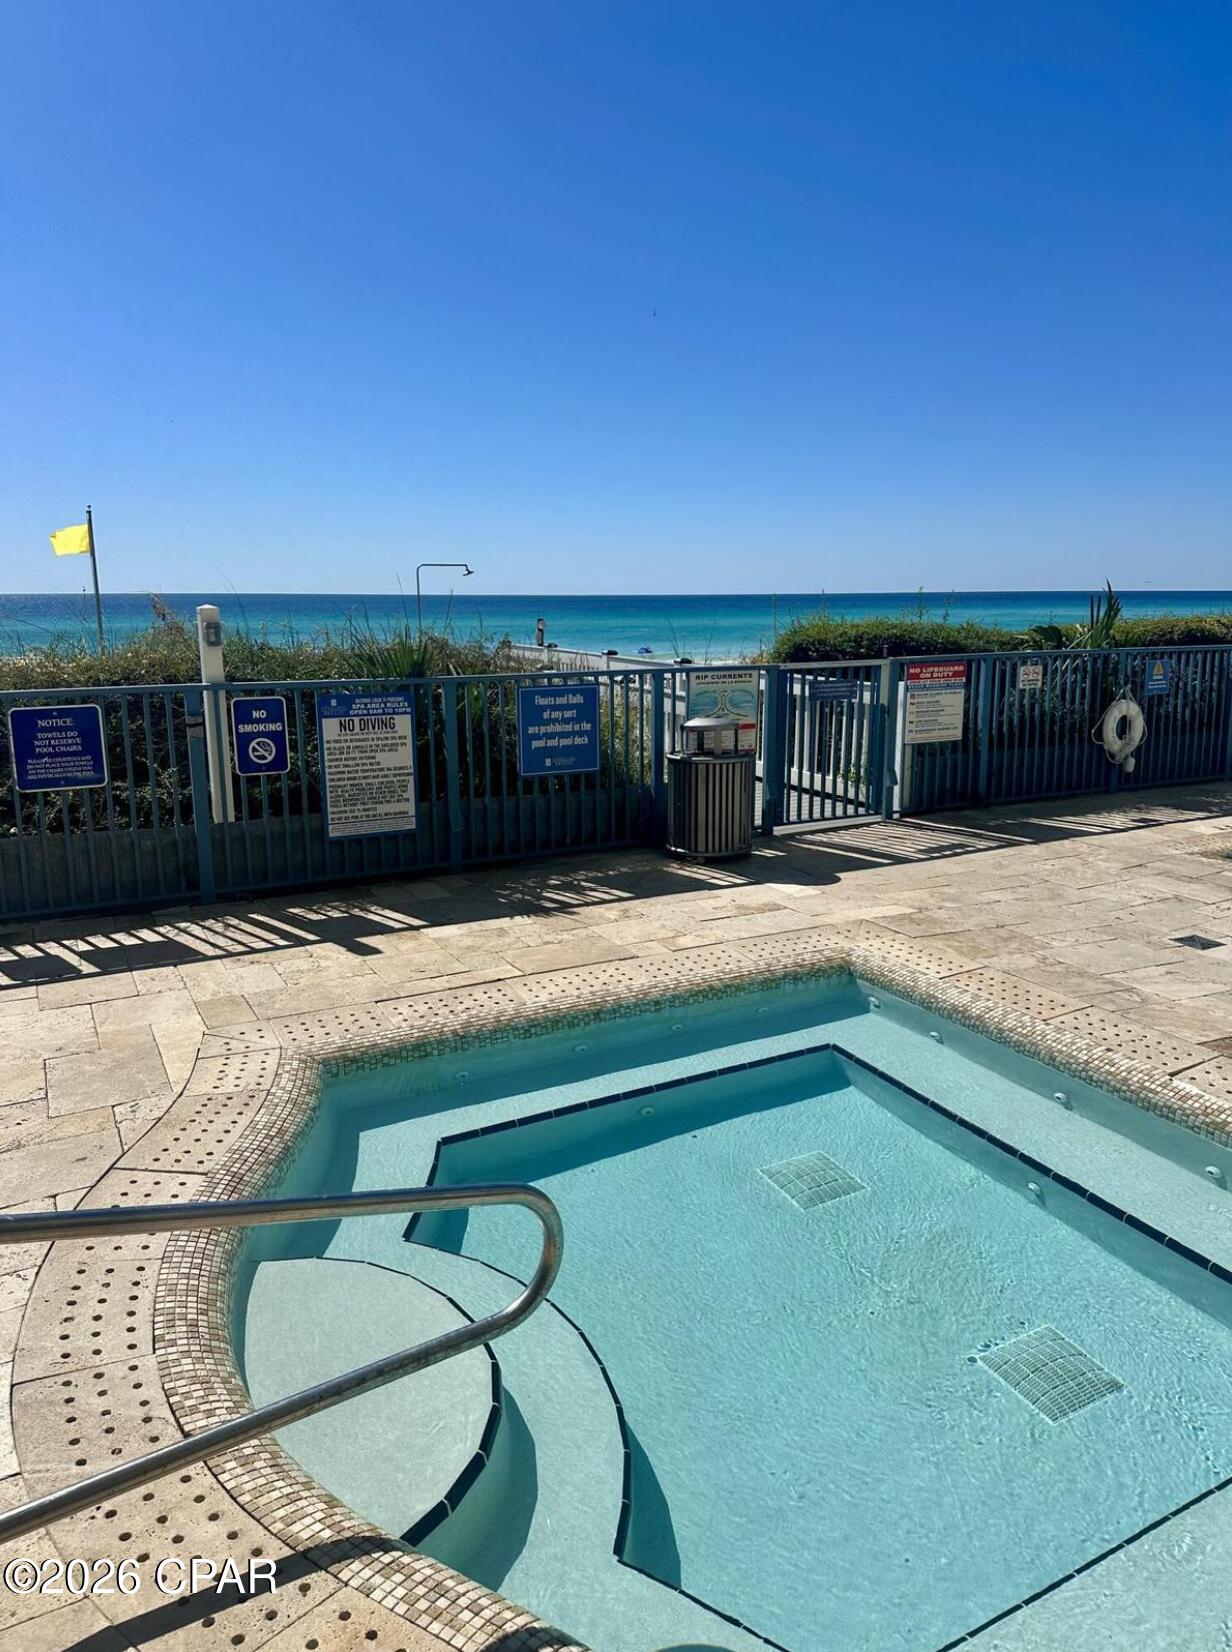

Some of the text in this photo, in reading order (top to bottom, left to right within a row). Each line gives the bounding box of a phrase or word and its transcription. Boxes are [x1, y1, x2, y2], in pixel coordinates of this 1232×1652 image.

[923, 665, 964, 673] LIFEGUARD
[535, 694, 584, 705] Floats and Balls
[252, 710, 266, 718] NO
[543, 709, 576, 721] of any sort
[238, 723, 283, 733] SMOKING
[339, 716, 395, 732] NO DIVING
[528, 720, 591, 736] are prohibited in the
[531, 734, 588, 750] pool and pool deck
